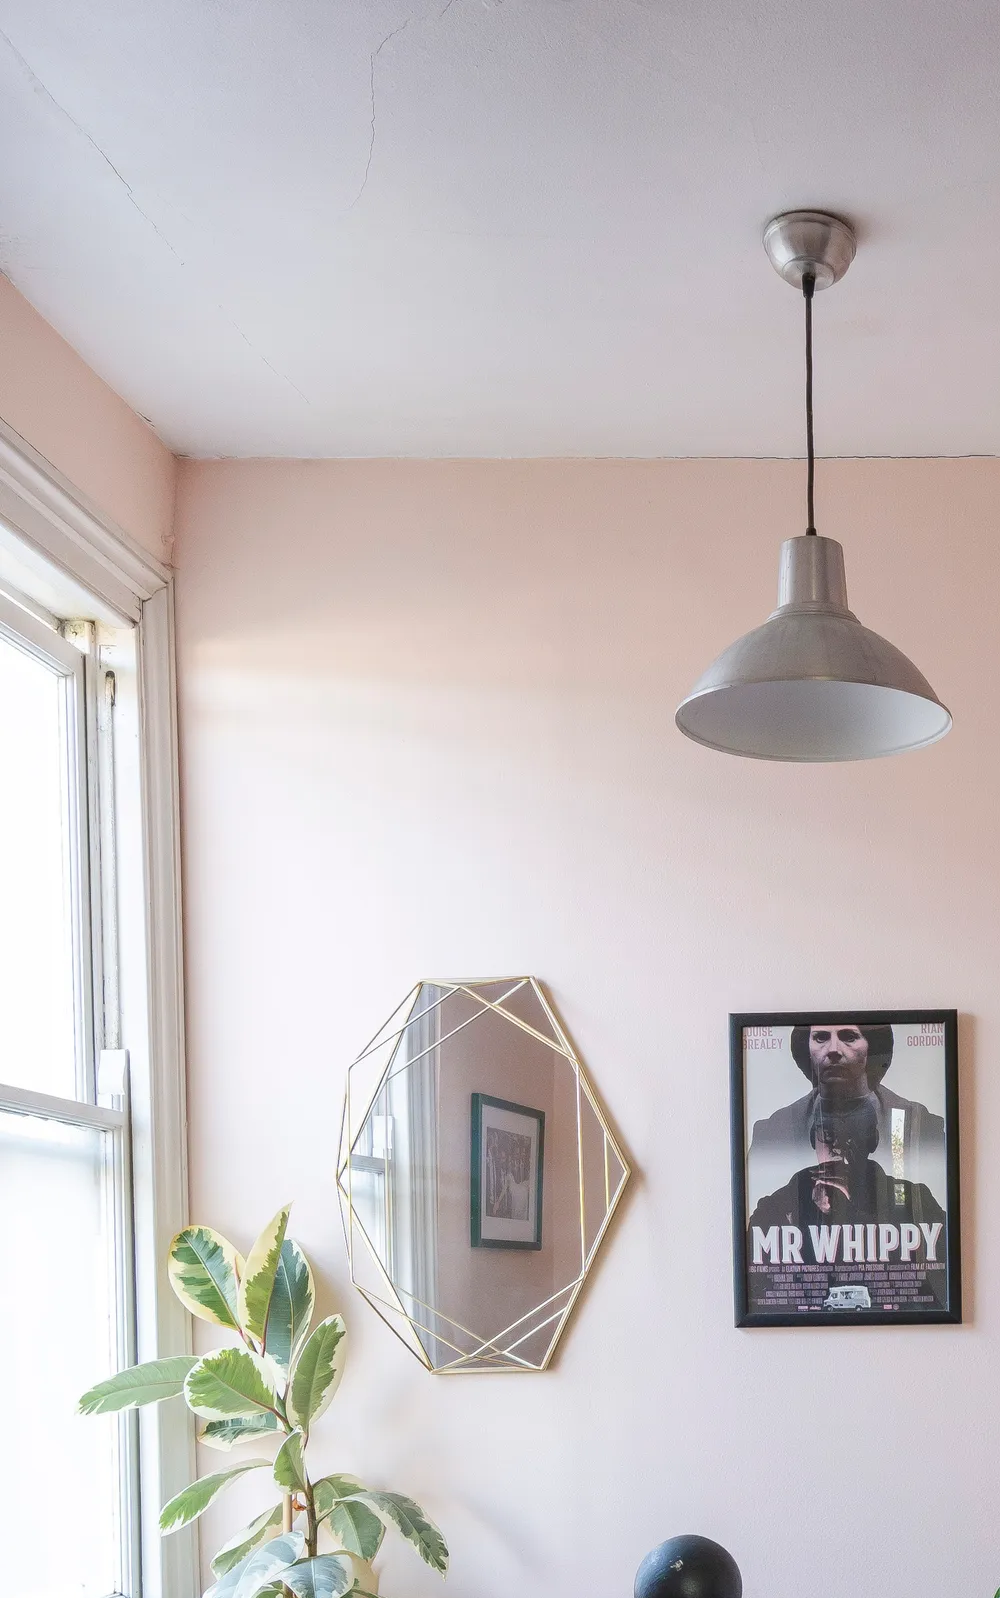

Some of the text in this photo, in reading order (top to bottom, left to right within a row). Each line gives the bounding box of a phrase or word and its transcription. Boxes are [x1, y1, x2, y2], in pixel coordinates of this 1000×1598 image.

[907, 1035, 944, 1047] GORDON
[752, 1223, 943, 1264] MR WHIPPY
